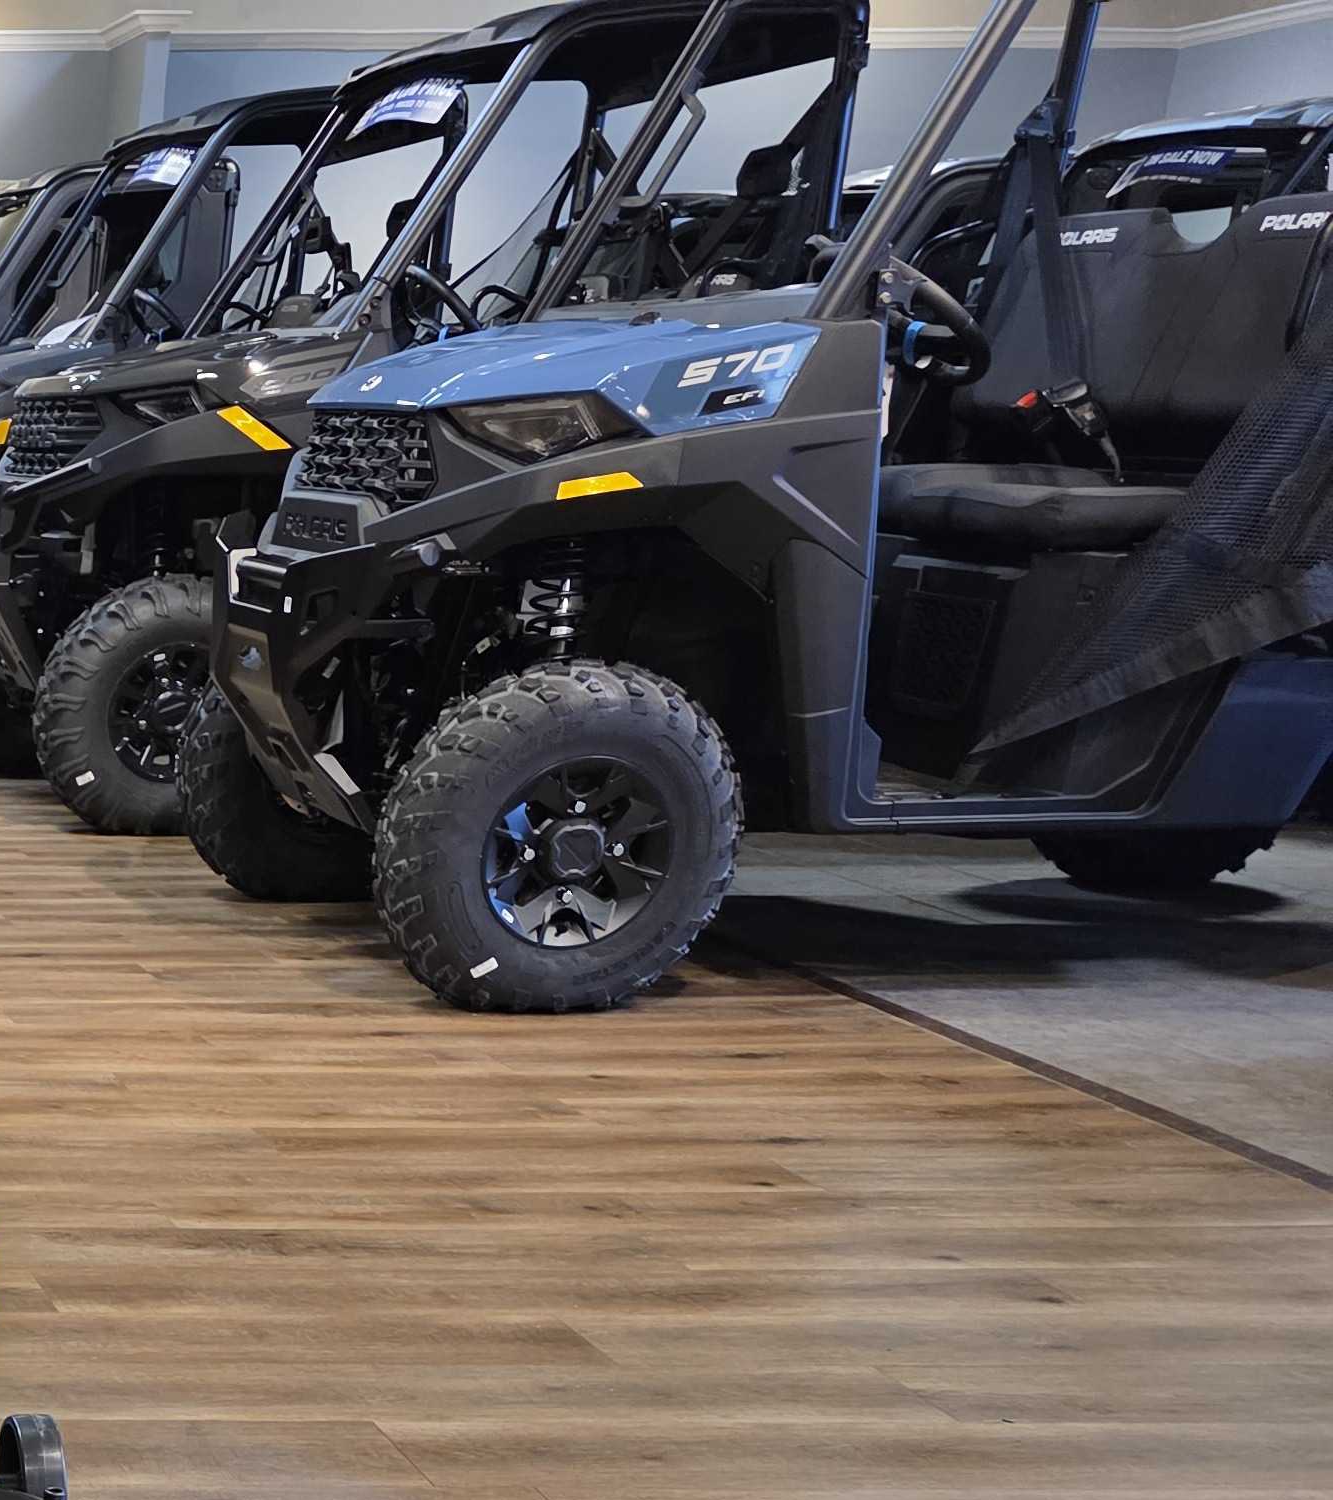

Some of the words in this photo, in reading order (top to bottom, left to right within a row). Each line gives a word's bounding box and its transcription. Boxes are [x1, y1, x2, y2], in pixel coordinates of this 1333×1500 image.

[1188, 150, 1226, 166] NOW
[1259, 210, 1331, 232] POLARI
[1059, 227, 1119, 247] OLARIS
[676, 343, 795, 389] 570
